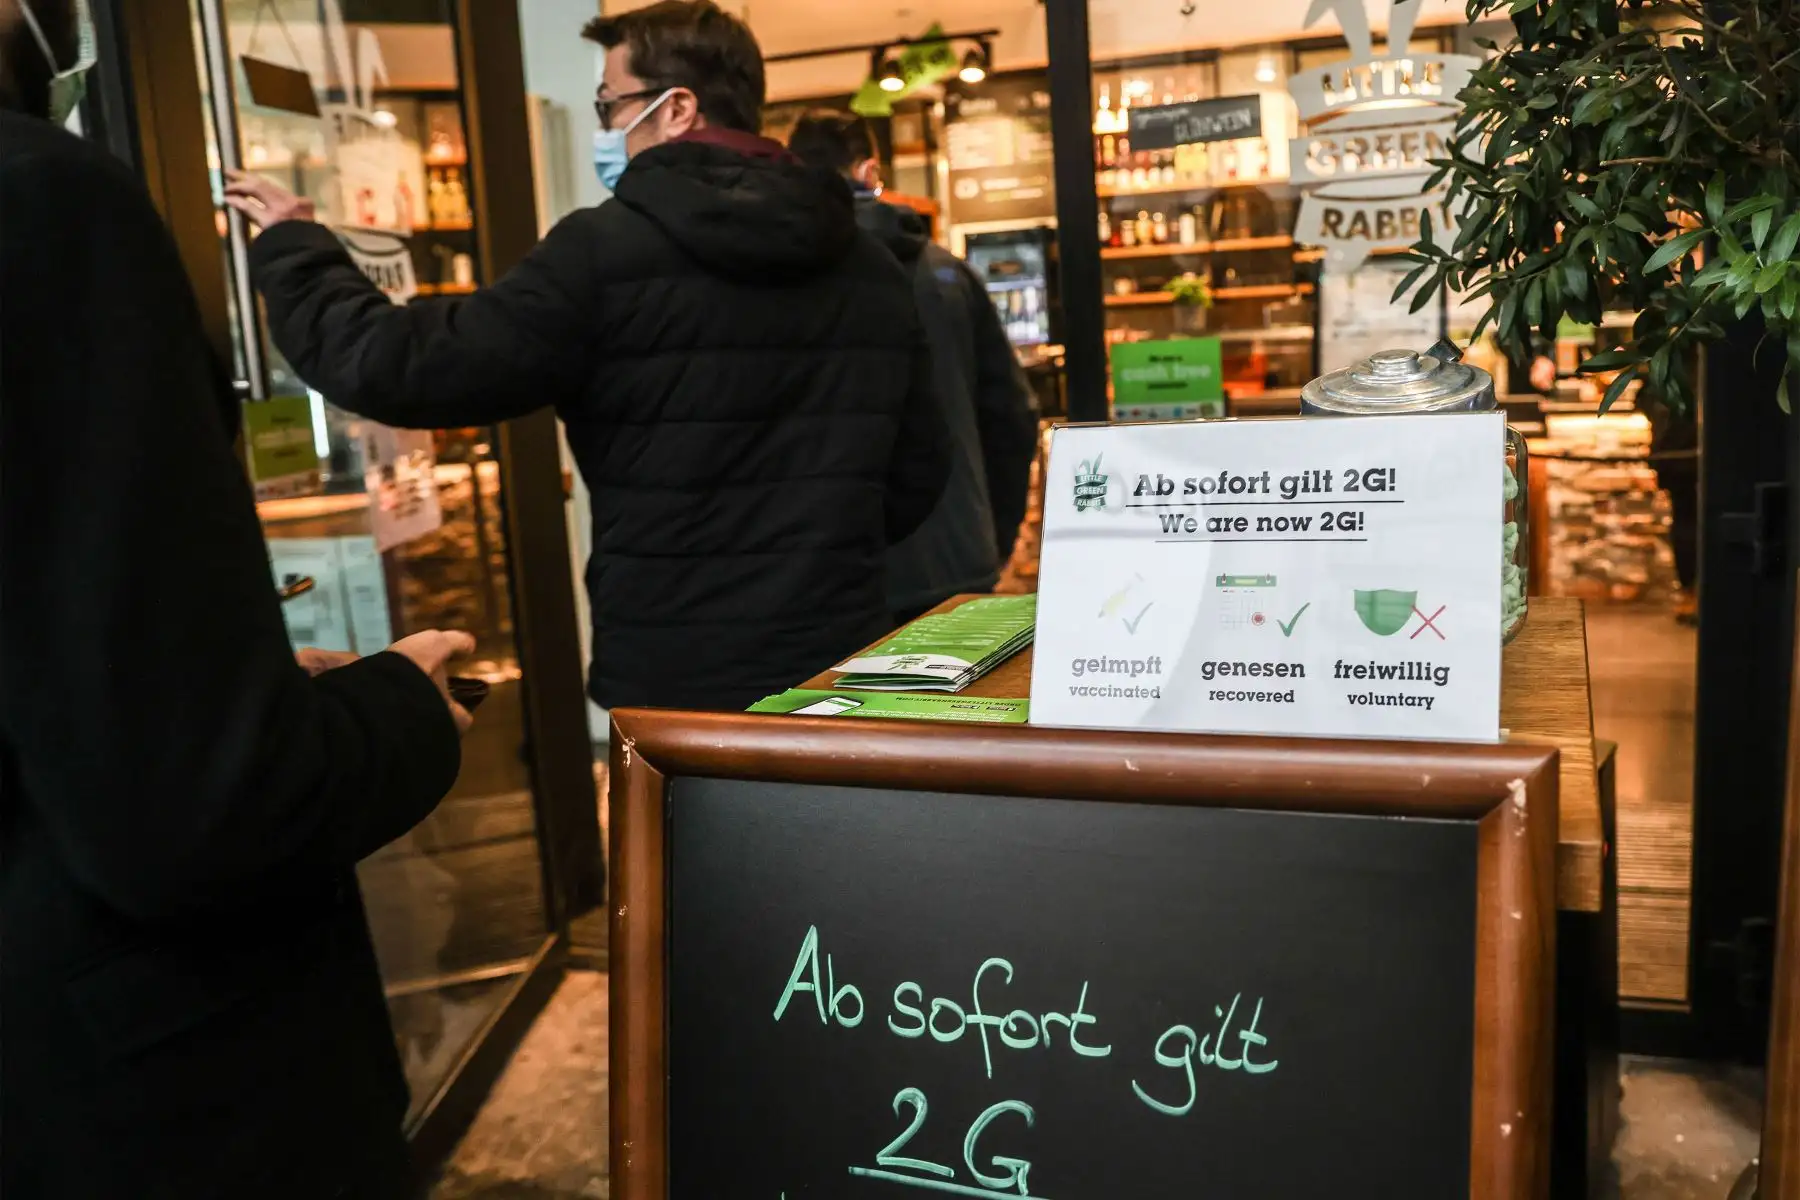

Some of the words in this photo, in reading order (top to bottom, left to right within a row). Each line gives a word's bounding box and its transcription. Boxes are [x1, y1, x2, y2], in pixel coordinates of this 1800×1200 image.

[1321, 58, 1445, 107] LITTLE
[1305, 131, 1454, 177] GREEN
[1132, 473, 1175, 497] Ab
[1183, 470, 1271, 496] sofort
[1279, 469, 1333, 500] gilt
[1343, 467, 1397, 493] 2G!
[1158, 513, 1198, 533] We
[1206, 515, 1249, 533] are
[1256, 515, 1312, 533] now
[1319, 511, 1365, 532] 2G!
[1070, 655, 1163, 678] geimpft
[1200, 659, 1306, 681] genesen
[1333, 659, 1451, 687] freiwillig
[1068, 683, 1162, 700] vaccinated
[1208, 688, 1295, 704] recovered
[1346, 691, 1435, 710] voluntary
[773, 924, 864, 1028] Ab
[888, 957, 1111, 1079] sofort
[1132, 992, 1278, 1116] gilt
